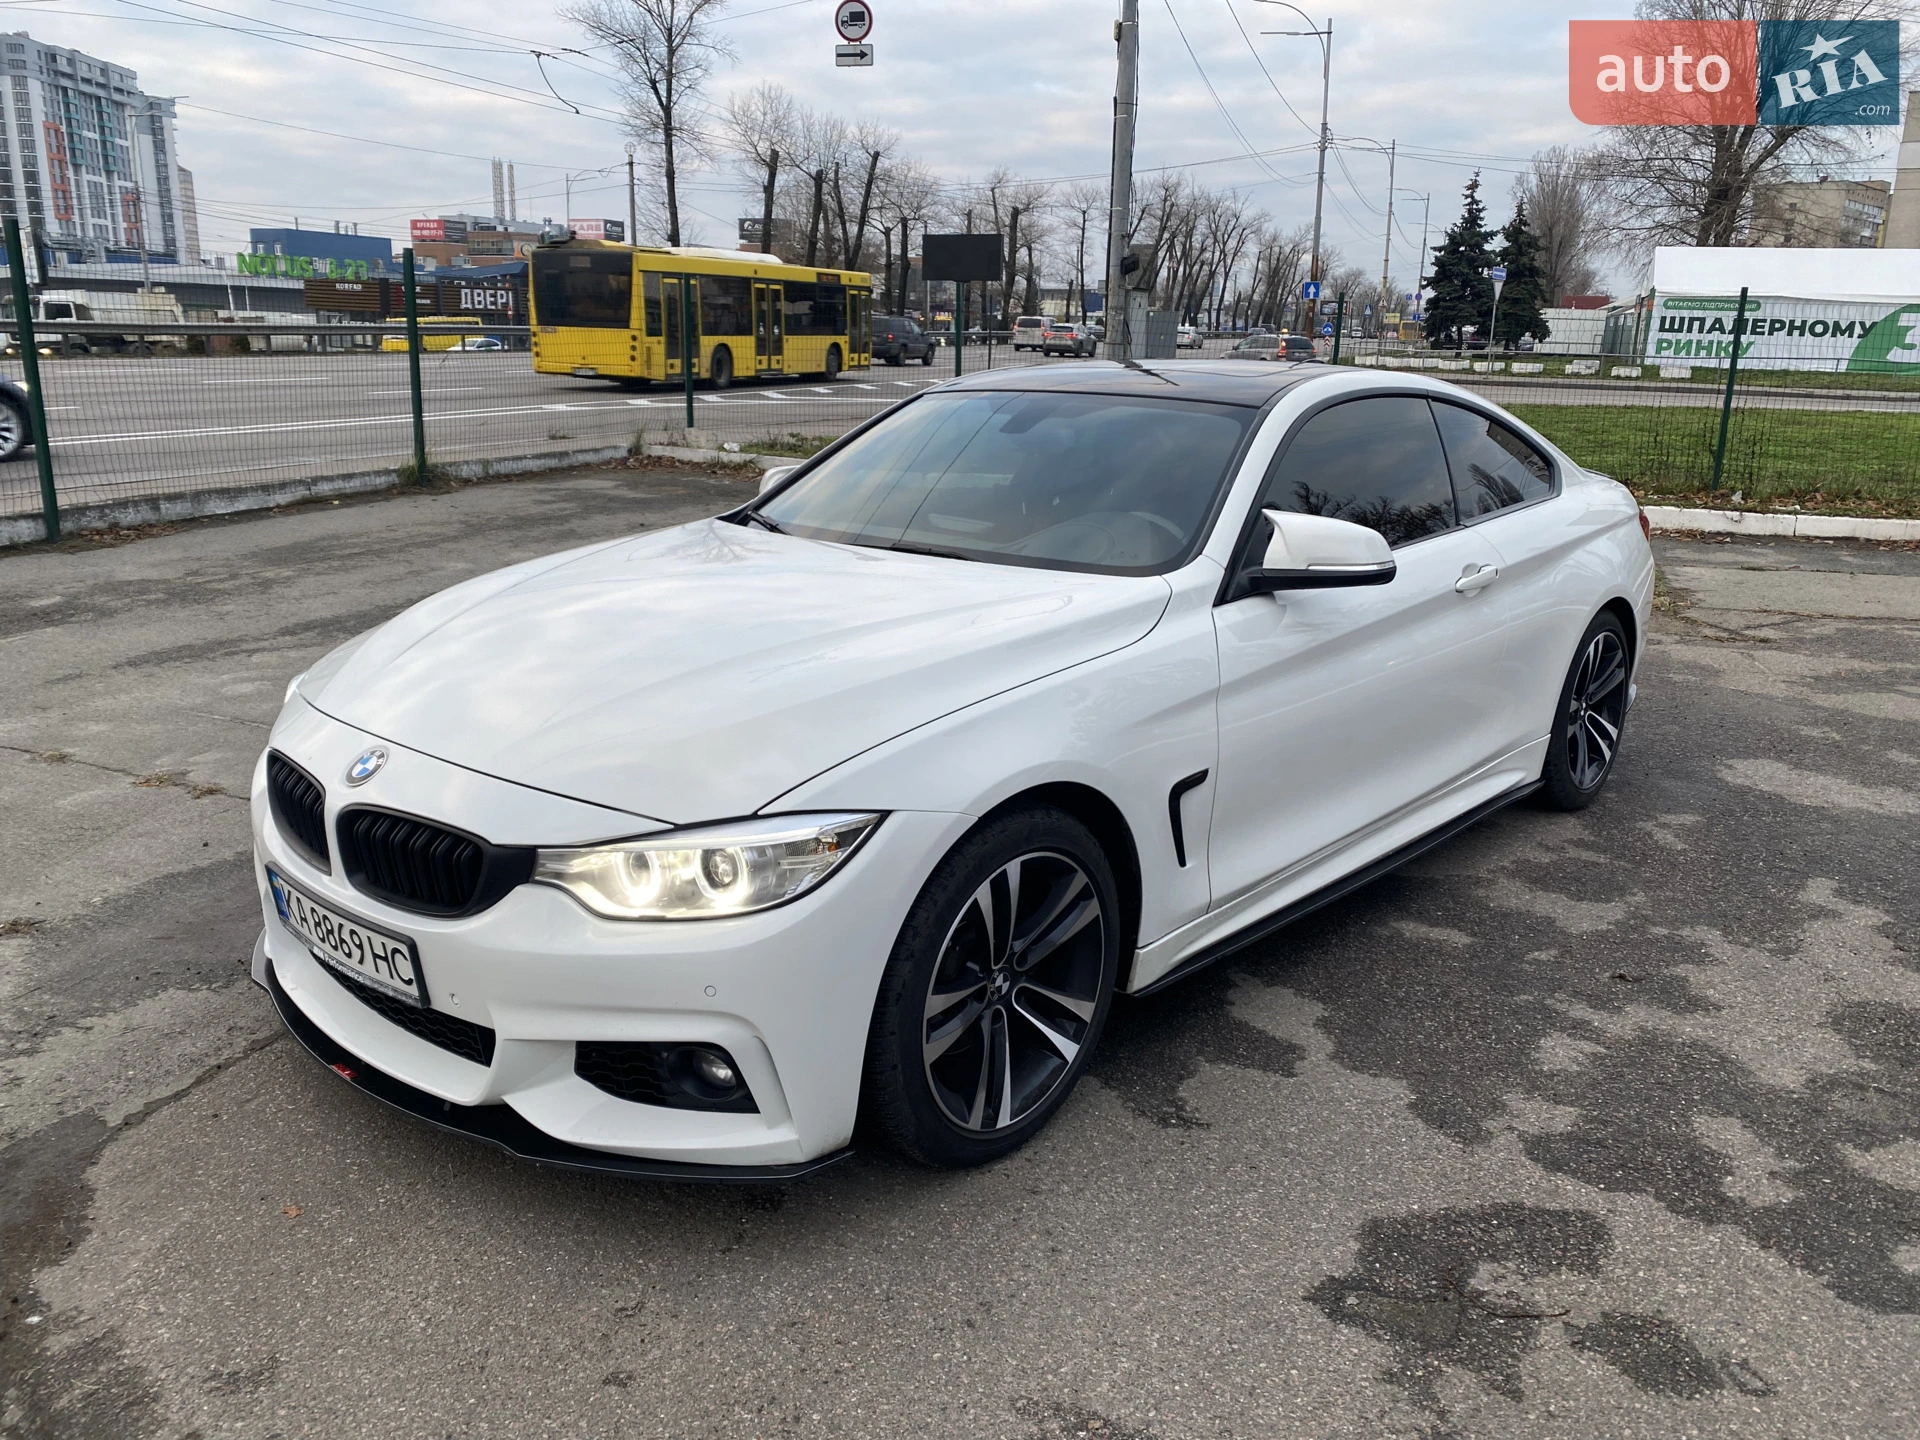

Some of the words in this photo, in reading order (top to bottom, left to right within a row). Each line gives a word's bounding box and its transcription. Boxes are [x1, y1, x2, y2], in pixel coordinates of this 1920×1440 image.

[460, 288, 514, 310] ДВЕРІ
[1658, 316, 1878, 339] ШПАЛЕРНОМУ
[1655, 338, 1755, 357] РИНКУ
